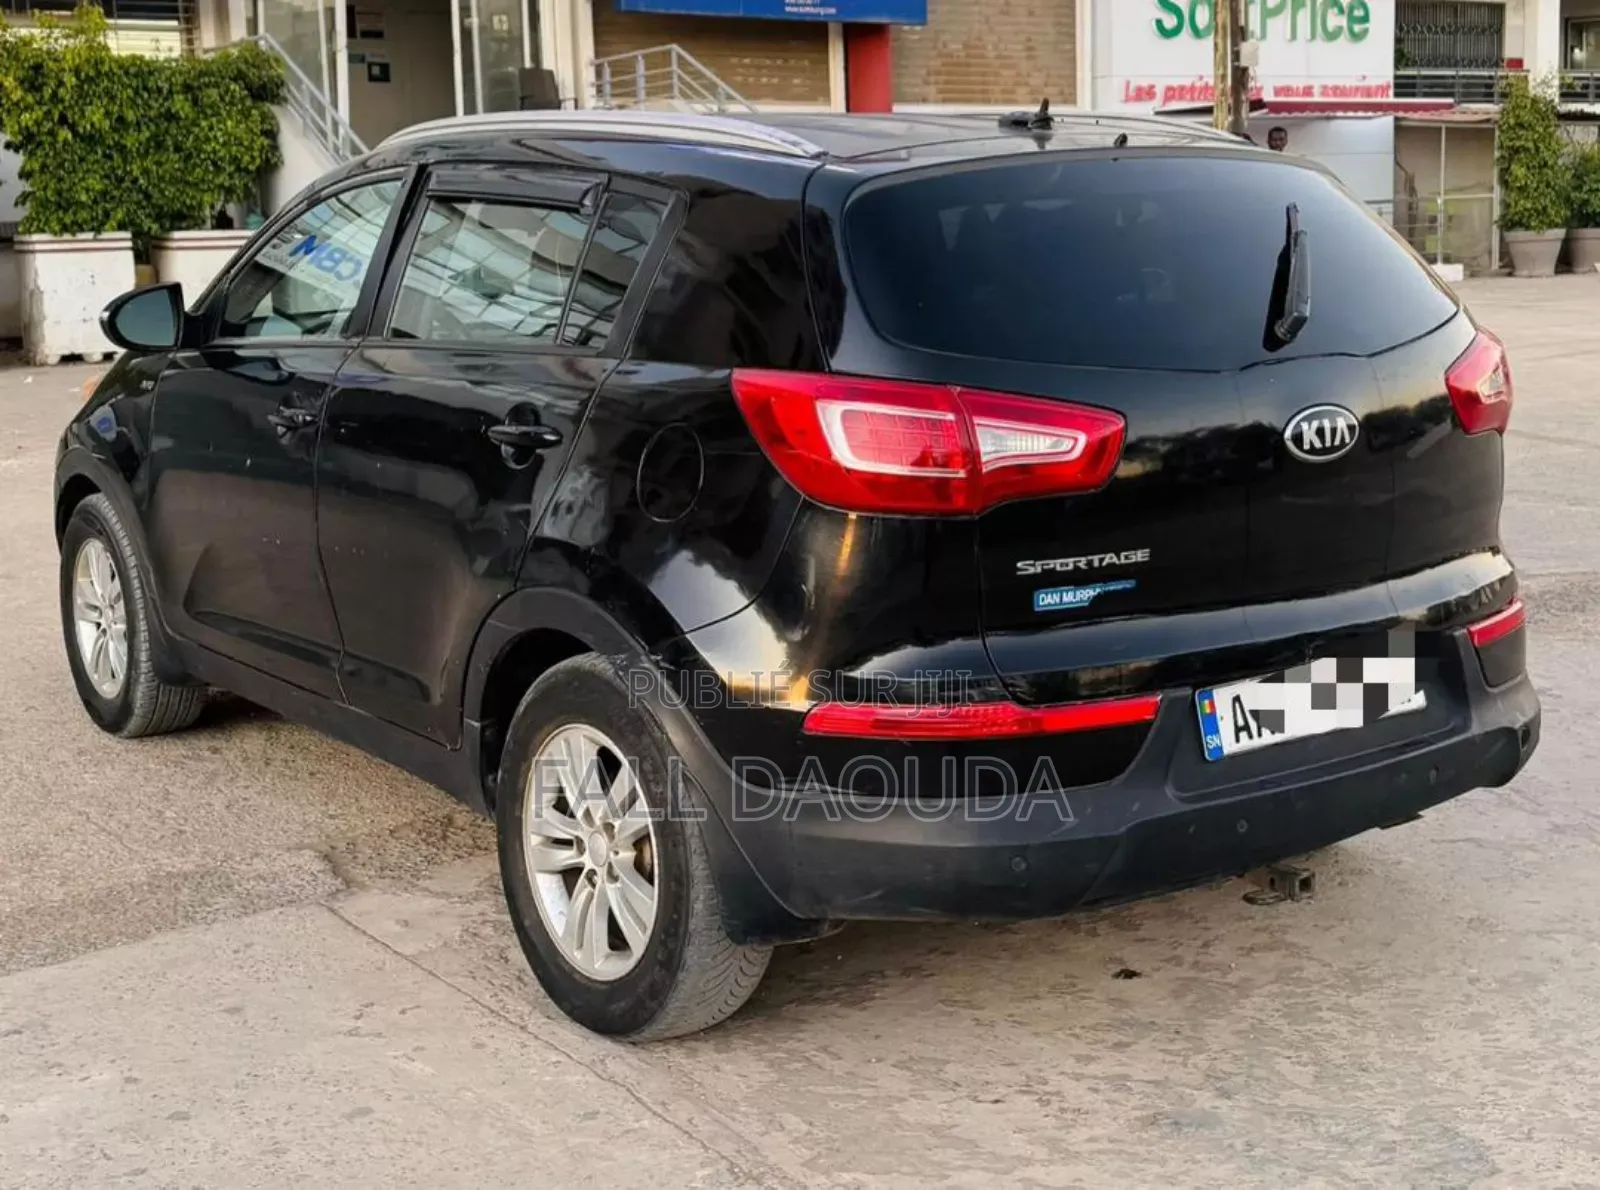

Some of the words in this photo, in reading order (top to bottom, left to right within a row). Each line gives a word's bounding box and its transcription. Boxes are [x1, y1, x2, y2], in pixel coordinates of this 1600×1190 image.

[1300, 416, 1351, 450] KIA
[1016, 548, 1150, 575] SPORTAGE
[1039, 592, 1061, 605] DAN
[1206, 734, 1221, 749] SN
